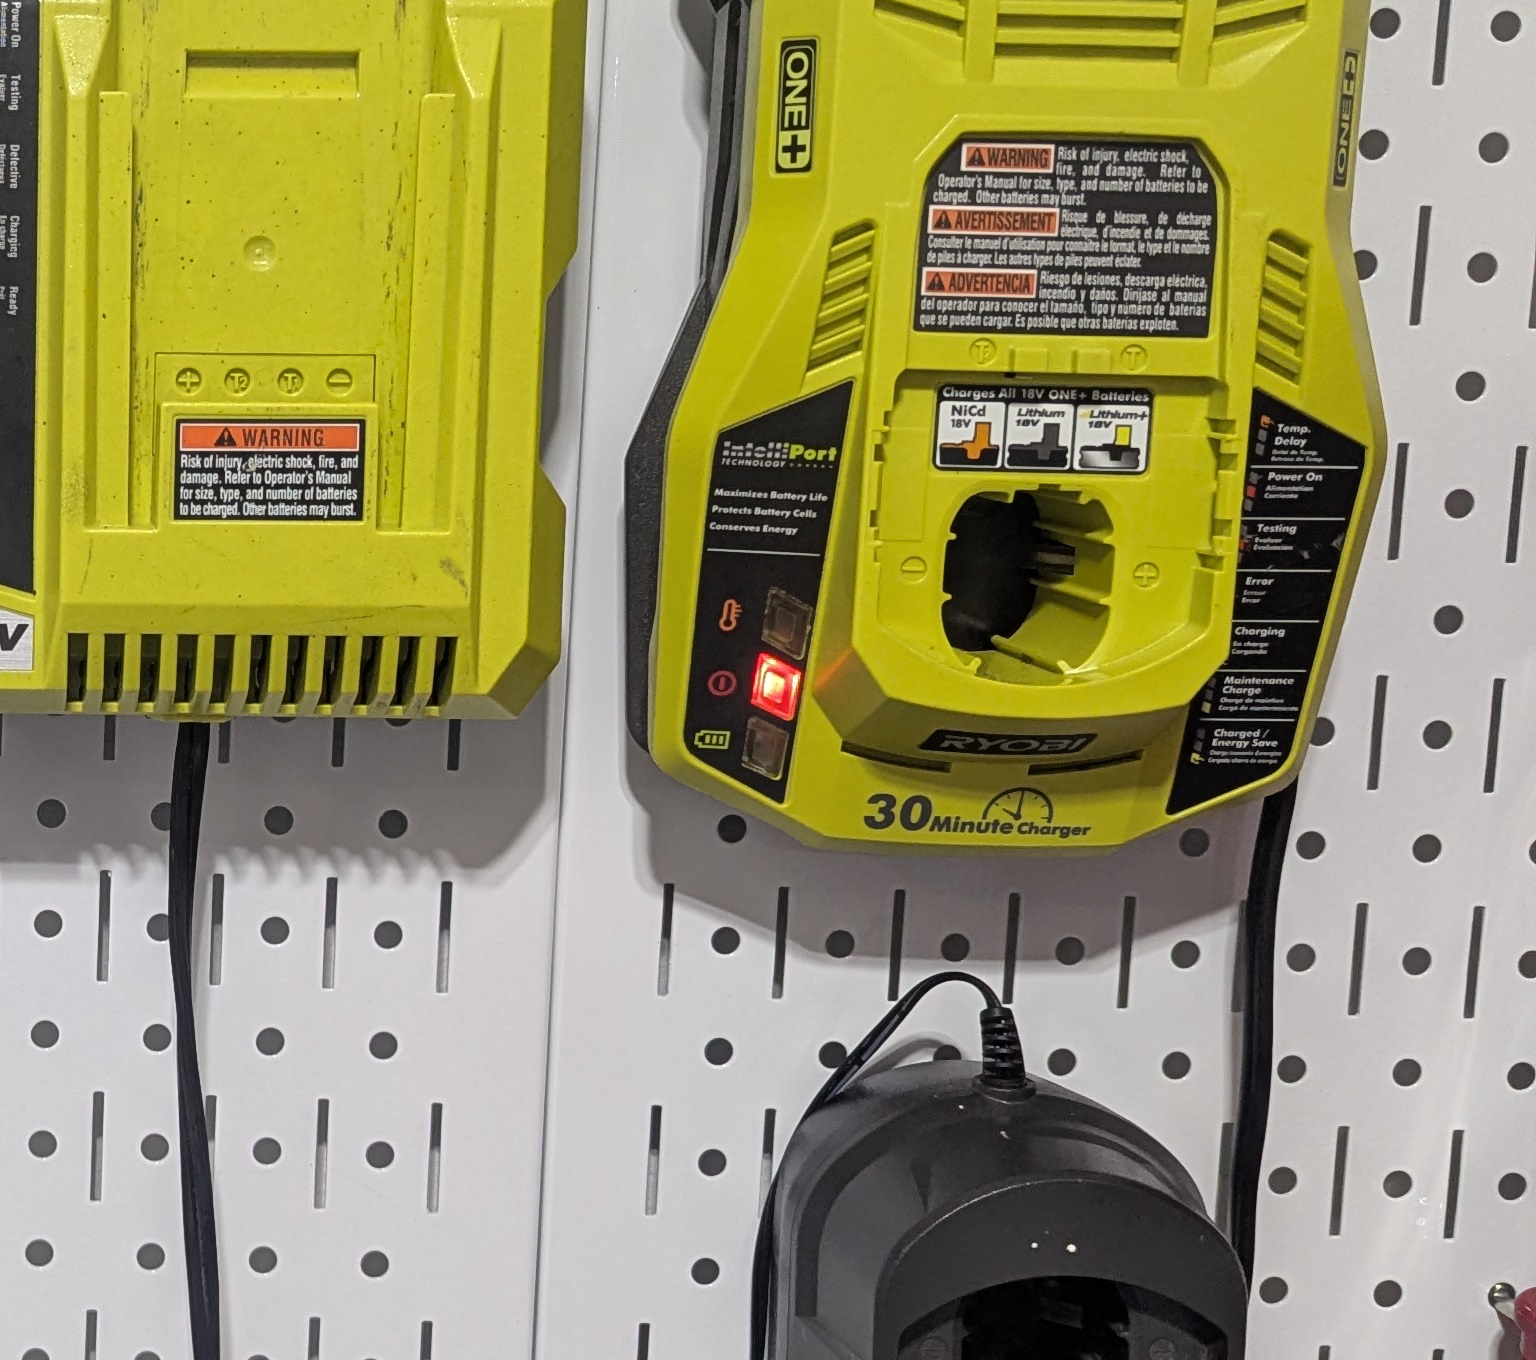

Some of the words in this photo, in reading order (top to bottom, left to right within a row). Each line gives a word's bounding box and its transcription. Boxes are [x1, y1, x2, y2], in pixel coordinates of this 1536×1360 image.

[11, 2, 21, 32] Power
[11, 35, 21, 48] On
[8, 75, 21, 110] Testing
[783, 51, 809, 170] ONE+
[1336, 54, 1356, 175] ONE+
[988, 149, 1048, 167] WARNING
[955, 212, 1054, 231] AVERTISSEMENT
[7, 216, 21, 258] Charging
[949, 274, 1031, 294] ADVERTENCIA
[7, 287, 19, 315] Ready
[943, 387, 995, 399] Charges
[998, 389, 1016, 398] All
[1022, 389, 1044, 399] 18V
[1049, 390, 1086, 400] ONE+
[1092, 392, 1149, 402] Batteries
[952, 405, 986, 416] NiCd
[1017, 409, 1064, 418] Lithium
[1090, 410, 1148, 419] Lithium+
[952, 419, 971, 428] 18V
[1277, 424, 1311, 434] Temp.
[242, 429, 324, 446] WARNING
[1274, 437, 1307, 447] Delay
[181, 454, 201, 468] Risk
[204, 455, 213, 468] of
[248, 455, 283, 468] electric
[285, 455, 315, 470] shock,
[319, 455, 337, 470] fire,
[341, 455, 358, 468] and
[722, 458, 786, 468] TECHNOLOGY
[180, 471, 221, 486] damage.
[225, 471, 250, 484] Refer
[253, 472, 261, 484] to
[265, 471, 313, 486] Operator's
[316, 471, 351, 484] Manual
[1268, 472, 1303, 481] Power
[1306, 473, 1323, 481] On
[180, 487, 193, 499] for
[195, 488, 216, 501] size,
[220, 488, 242, 502] type,
[246, 487, 263, 500] and
[266, 487, 301, 500] number
[305, 487, 314, 500] of
[316, 487, 357, 500] batteries
[714, 488, 768, 498] Maximizes
[770, 491, 807, 502] Battery
[809, 493, 828, 502] Life
[180, 504, 188, 515] to
[191, 502, 201, 515] be
[203, 502, 240, 518] charged.
[243, 502, 266, 515] Other
[268, 503, 307, 516] batteries
[309, 504, 329, 518] may
[331, 502, 356, 516] burst.
[712, 505, 752, 514] Protects
[754, 508, 791, 518] Battery
[793, 509, 817, 518] Cells
[709, 522, 760, 532] Conserves
[763, 525, 798, 535] Energy
[1258, 524, 1297, 534] Testing
[1246, 577, 1274, 585] Error
[1235, 627, 1285, 637] Charging
[1224, 677, 1294, 685] Maintenance
[1223, 686, 1261, 695] Charge
[1214, 729, 1260, 738] Charged
[940, 735, 1087, 753] RYOBI
[1212, 739, 1248, 748] Energy
[1252, 739, 1278, 747] Save
[864, 794, 932, 831] 30
[930, 816, 1013, 834] Minute
[1017, 822, 1091, 838] Charger
